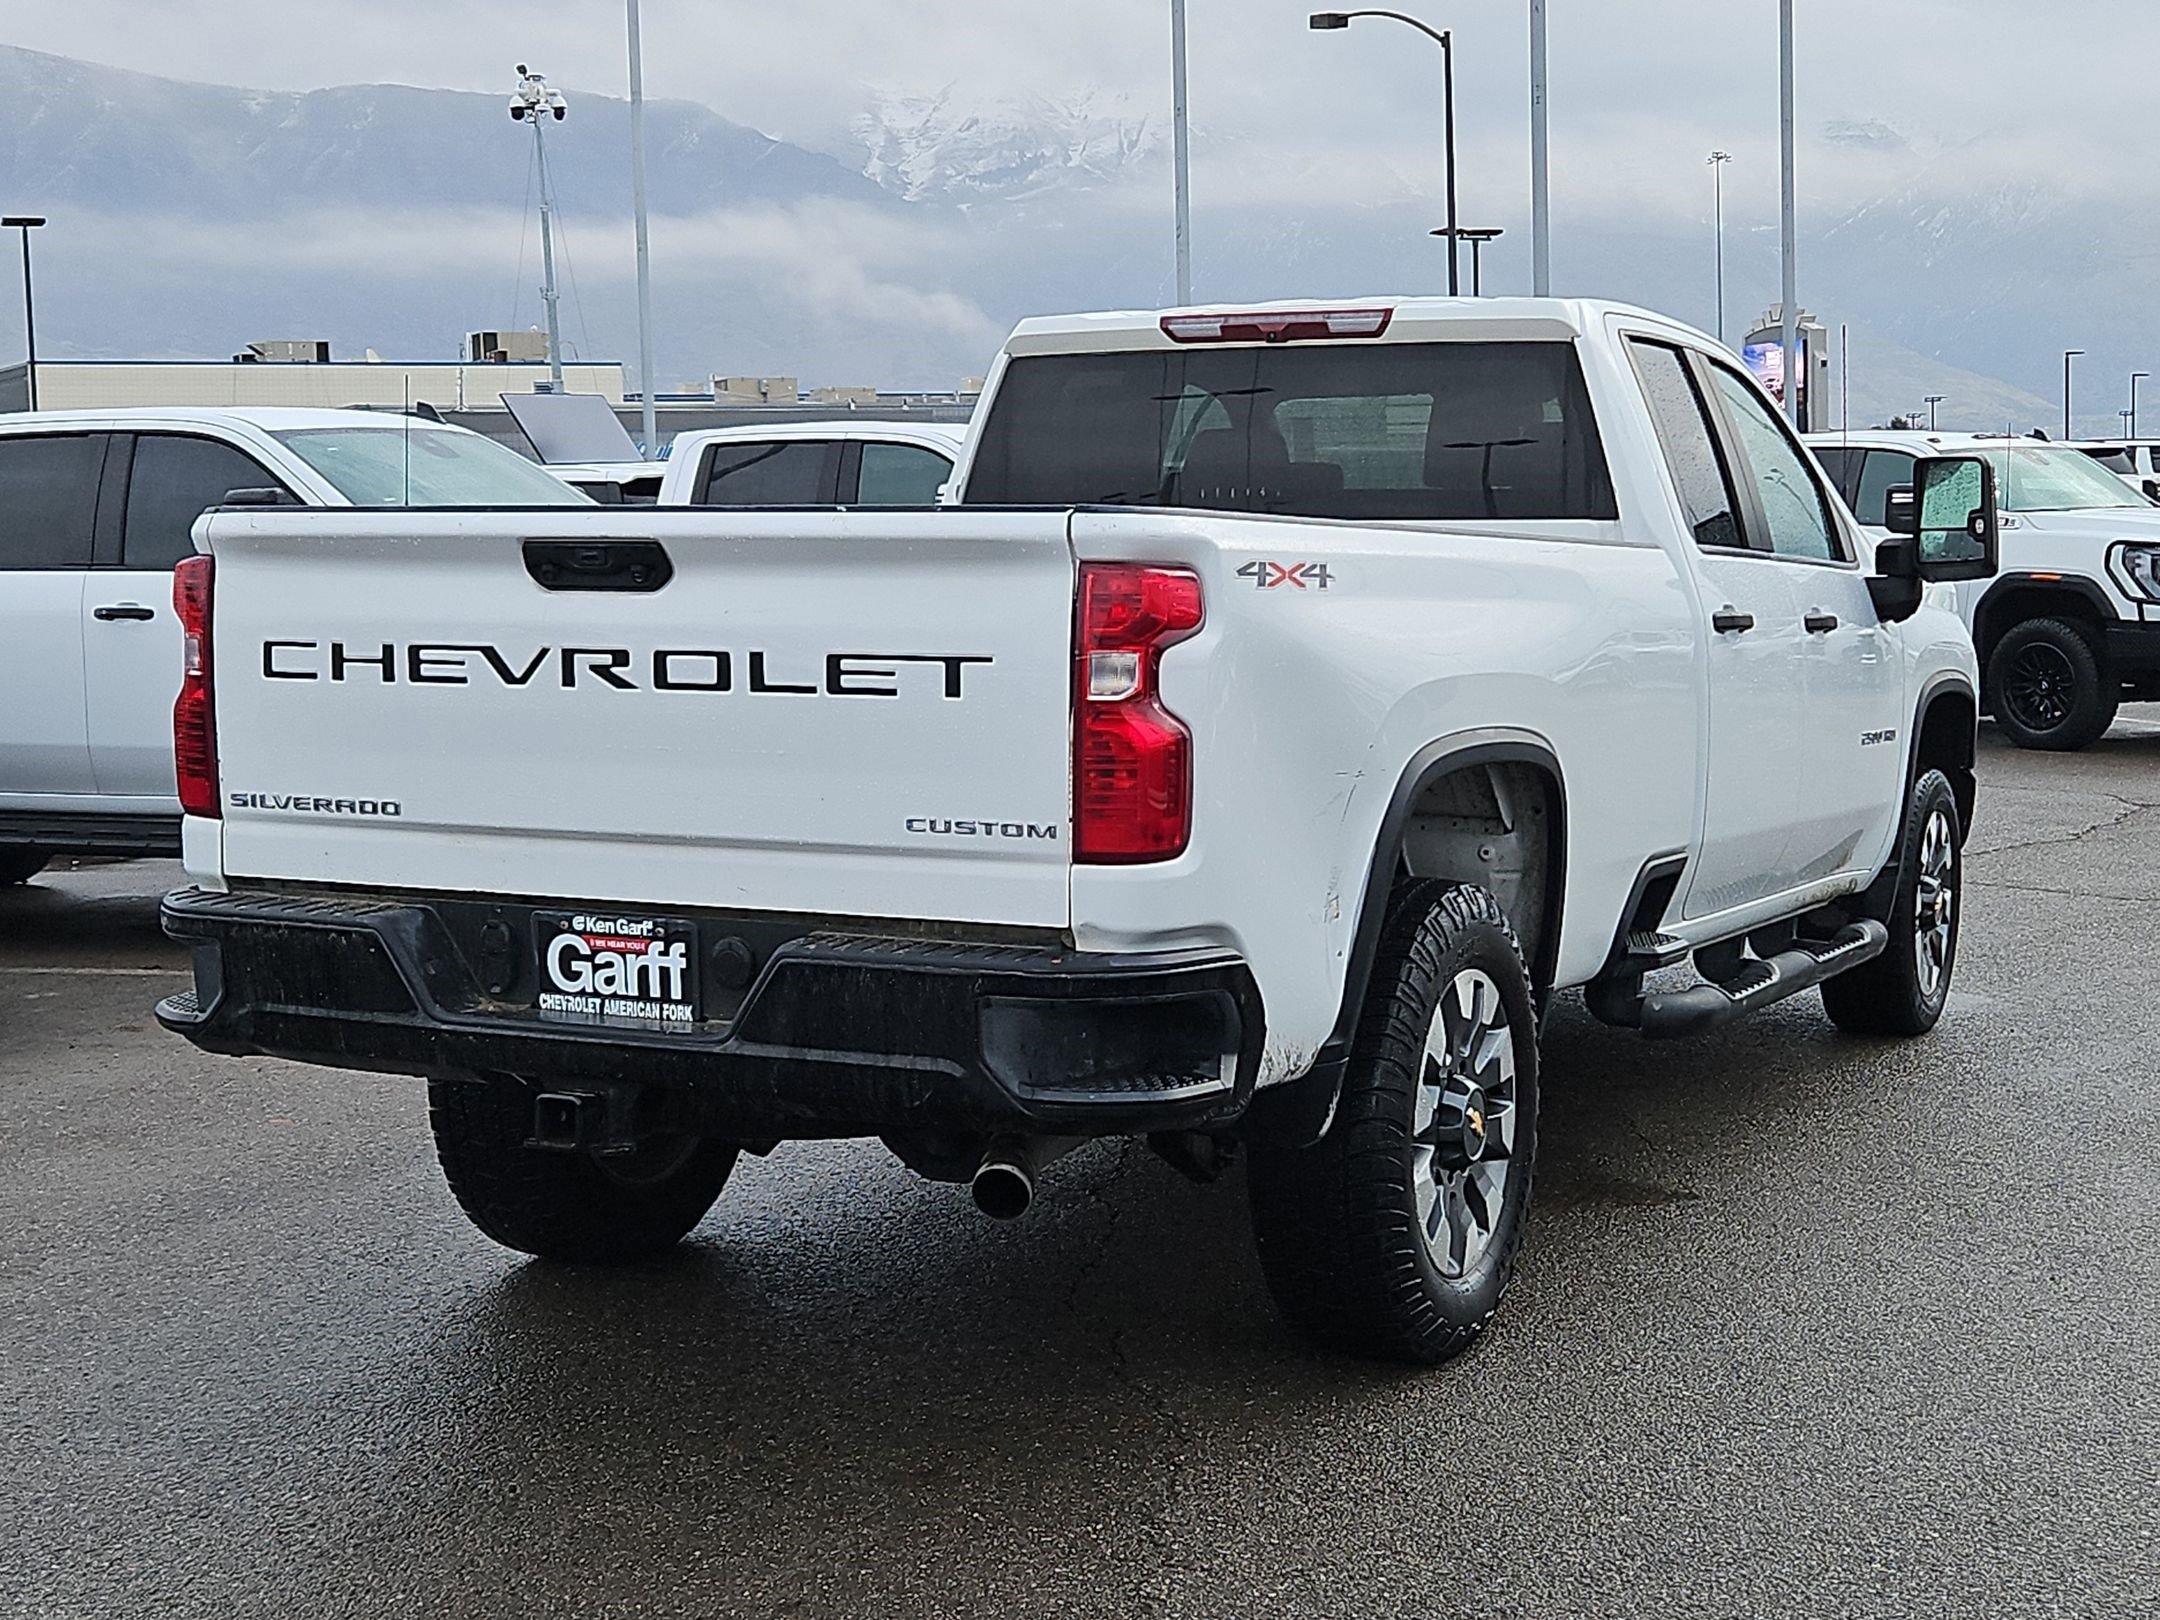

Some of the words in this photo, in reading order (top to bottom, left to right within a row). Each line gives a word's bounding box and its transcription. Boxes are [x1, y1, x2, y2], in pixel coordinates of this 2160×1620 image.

[262, 640, 994, 699] CHEVROLET
[230, 793, 402, 817] SILVERADO
[905, 818, 1058, 840] CUSTOM
[586, 916, 615, 934] Ken
[547, 933, 687, 1000] Garff
[538, 993, 602, 1015] CHEVROLET
[604, 999, 660, 1019] AMERICAN
[662, 1003, 694, 1022] FORK
